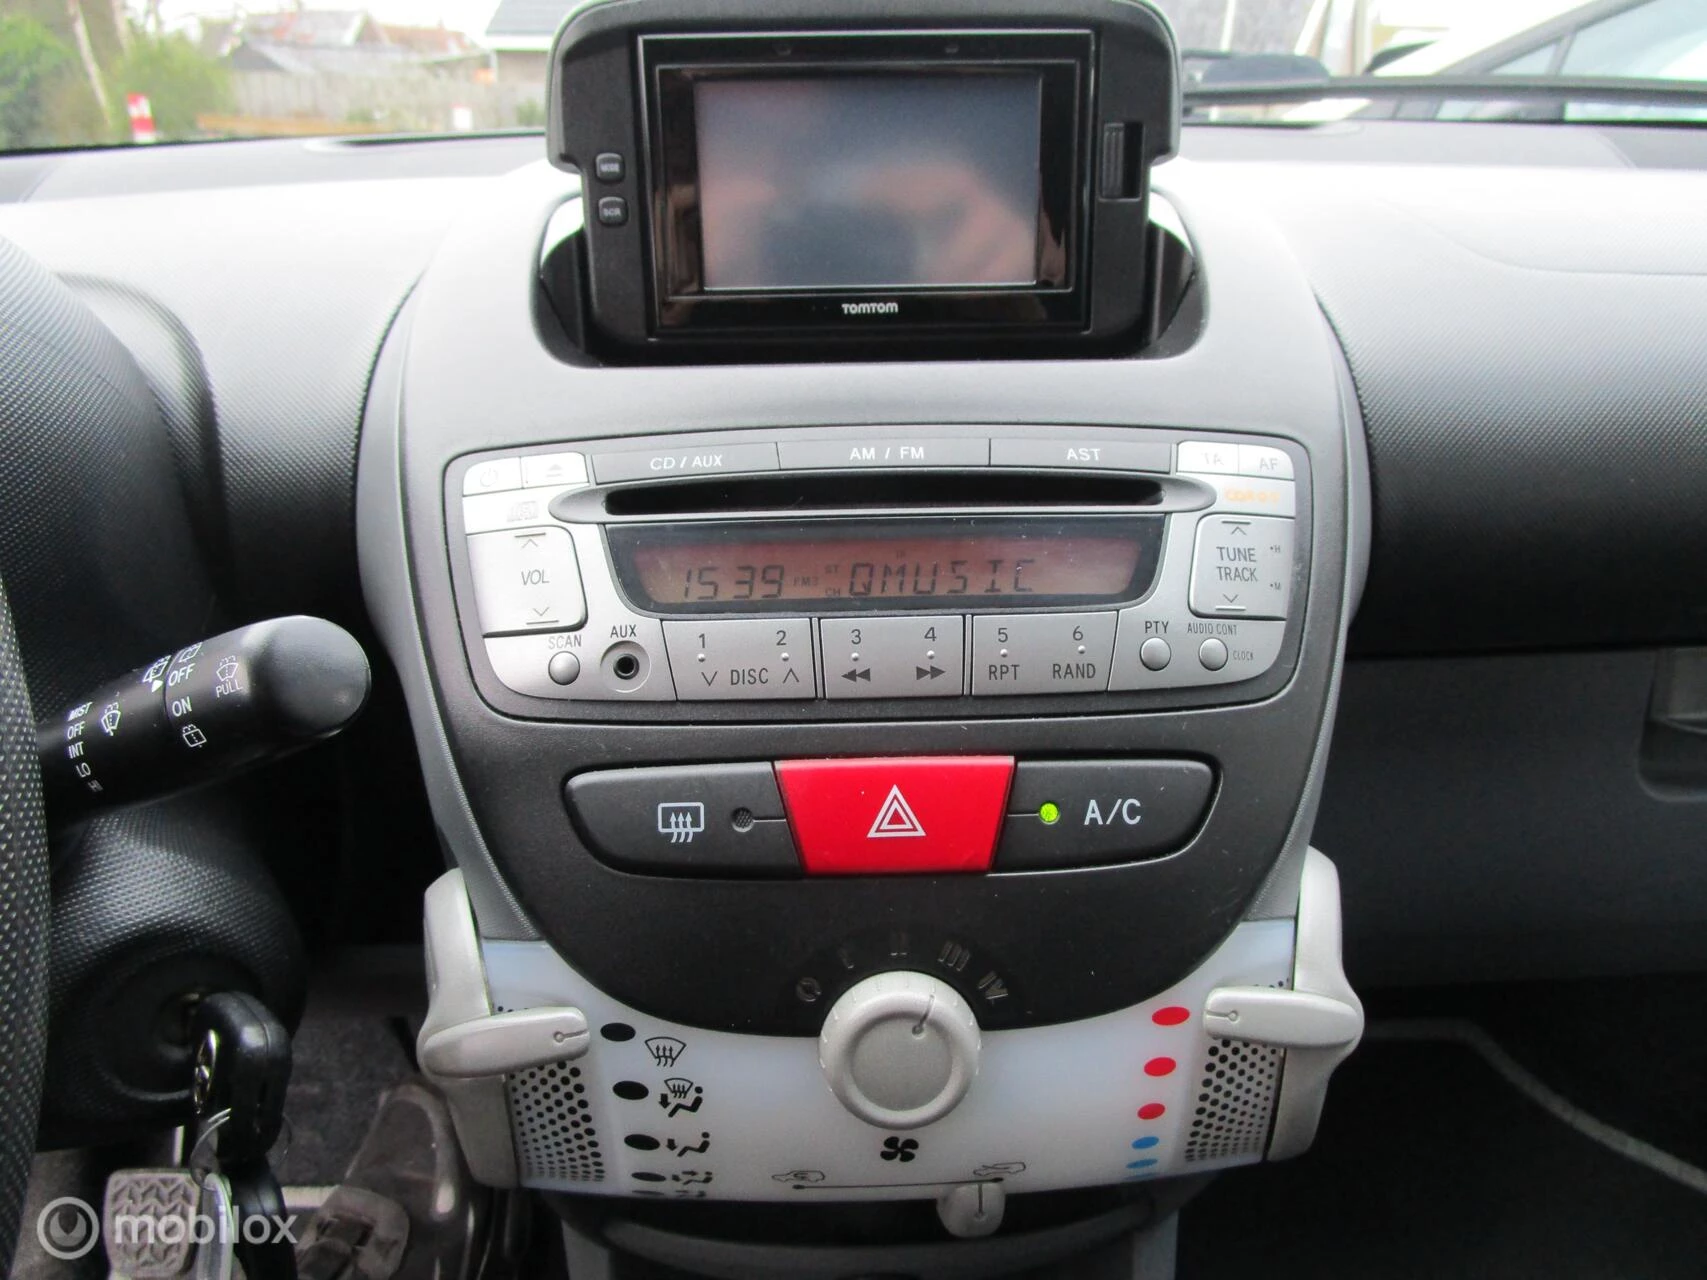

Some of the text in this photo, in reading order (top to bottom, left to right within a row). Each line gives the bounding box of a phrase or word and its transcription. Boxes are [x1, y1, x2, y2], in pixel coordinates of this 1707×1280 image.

[849, 447, 876, 460] AM
[900, 446, 925, 460] FM
[1066, 447, 1101, 461] AST
[650, 457, 676, 470] CD
[691, 454, 723, 468] AUX
[1259, 457, 1279, 470] AF
[1215, 546, 1257, 562] TUNE
[520, 568, 551, 586] VOL
[848, 558, 1036, 596] QMUSIC
[1216, 566, 1258, 582] TRACK
[610, 624, 637, 638] AUX
[923, 626, 937, 642] 4
[997, 627, 1009, 643] 5
[1072, 625, 1084, 641] 6
[1144, 621, 1169, 634] PTY
[1187, 622, 1238, 635] AUDIO CONT
[547, 634, 582, 650] SCAN
[698, 633, 706, 649] 1
[775, 630, 787, 646] 2
[850, 628, 862, 645] 3
[168, 663, 196, 687] OFF
[730, 668, 769, 685] DISC
[988, 664, 1020, 681] RPT
[1052, 663, 1097, 680] RAND
[215, 679, 243, 698] PULL
[172, 695, 193, 717] ON
[67, 721, 86, 740] OFF
[68, 741, 84, 759] INT
[76, 762, 91, 778] LO
[1083, 798, 1142, 826] A/C
